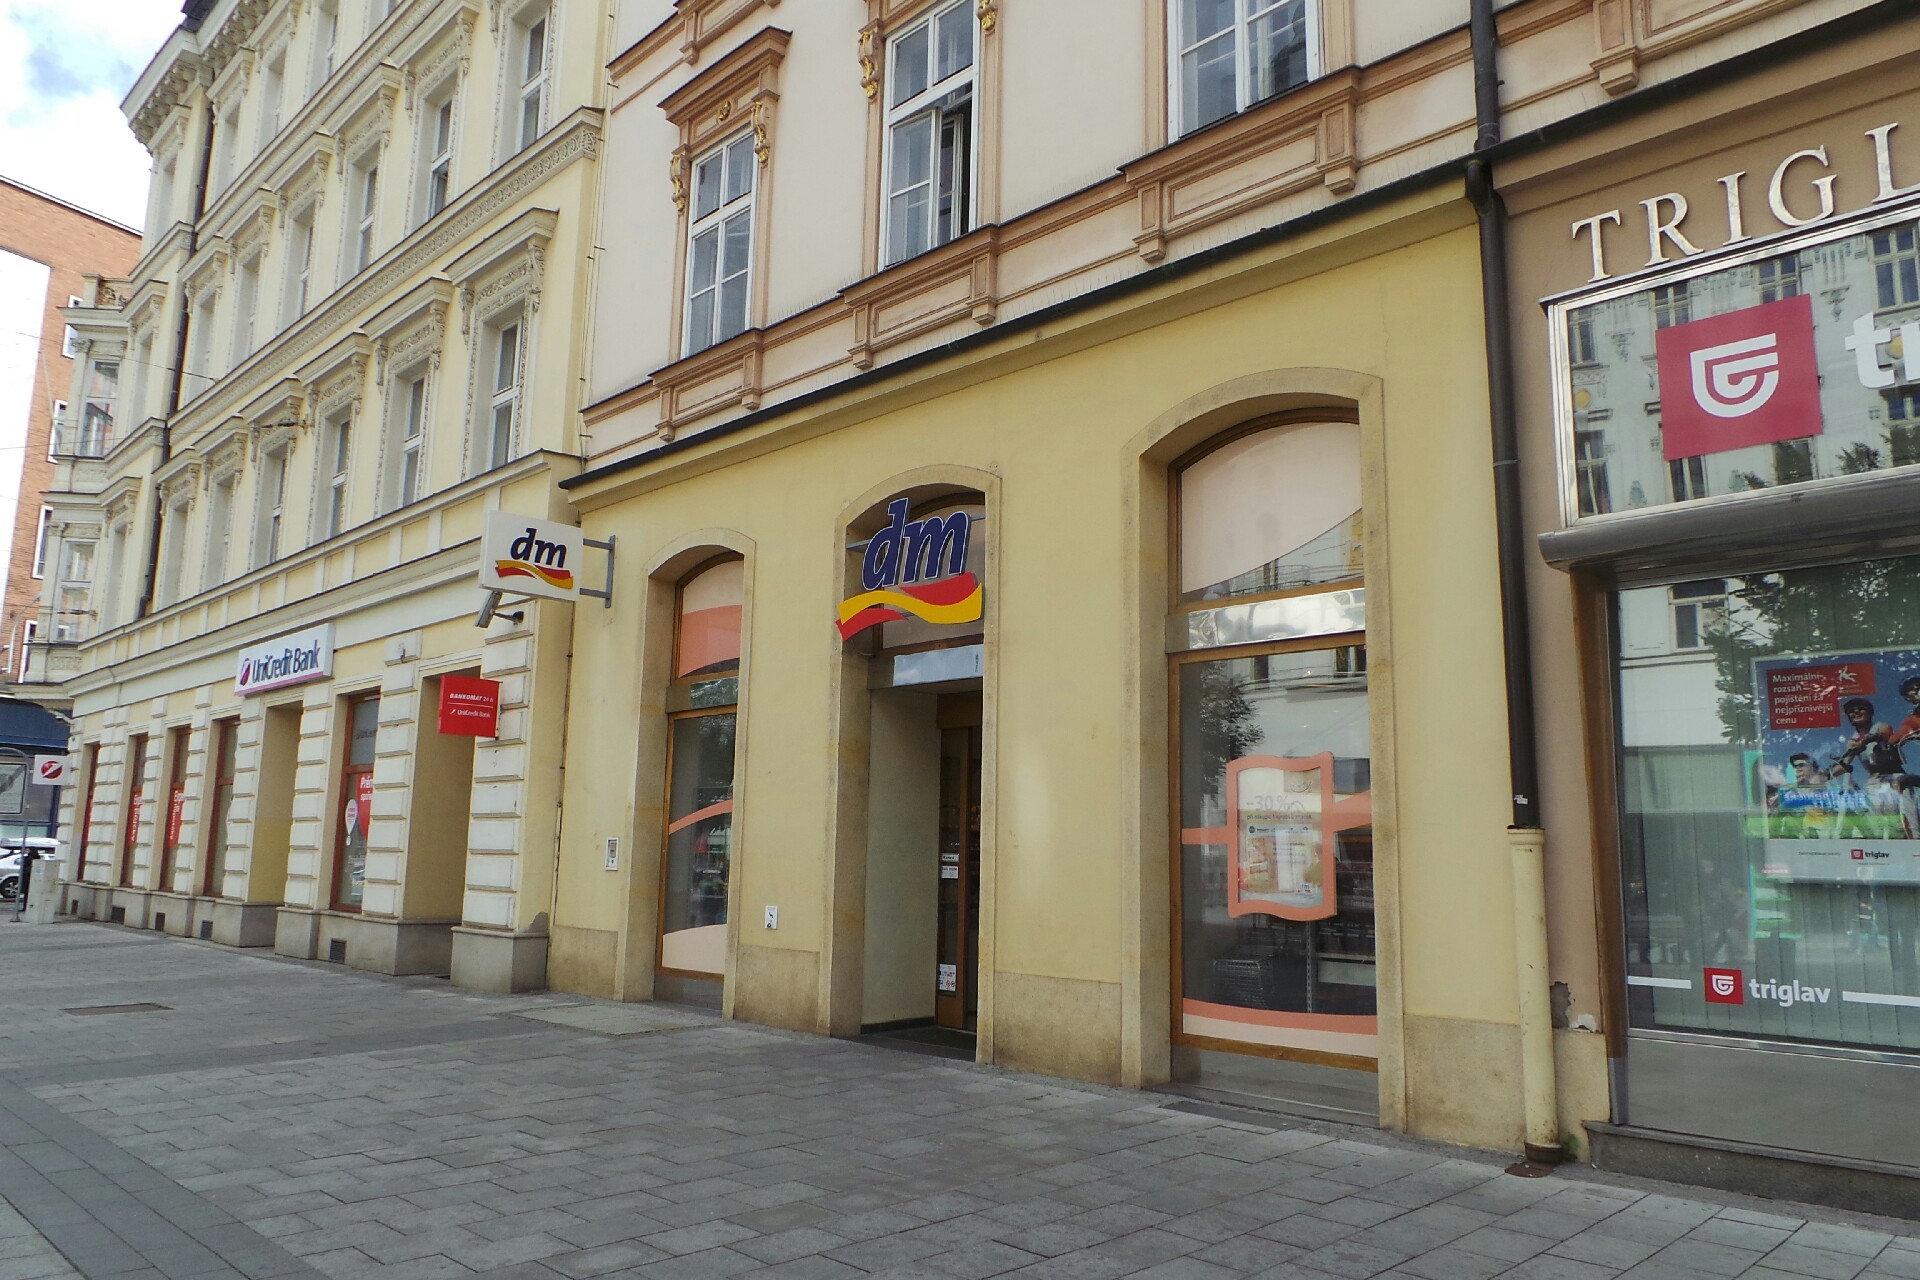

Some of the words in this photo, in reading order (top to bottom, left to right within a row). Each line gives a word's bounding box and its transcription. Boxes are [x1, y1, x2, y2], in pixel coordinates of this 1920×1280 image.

[510, 527, 568, 569] dm
[862, 498, 971, 591] dm
[253, 647, 293, 683] UniCredit
[293, 640, 320, 674] Bank
[449, 693, 482, 701] BANKOMAT
[1773, 682, 1802, 693] rozsah
[1776, 717, 1797, 725] cenu
[1865, 850, 1890, 860] triglav
[1748, 978, 1831, 1008] triglav
